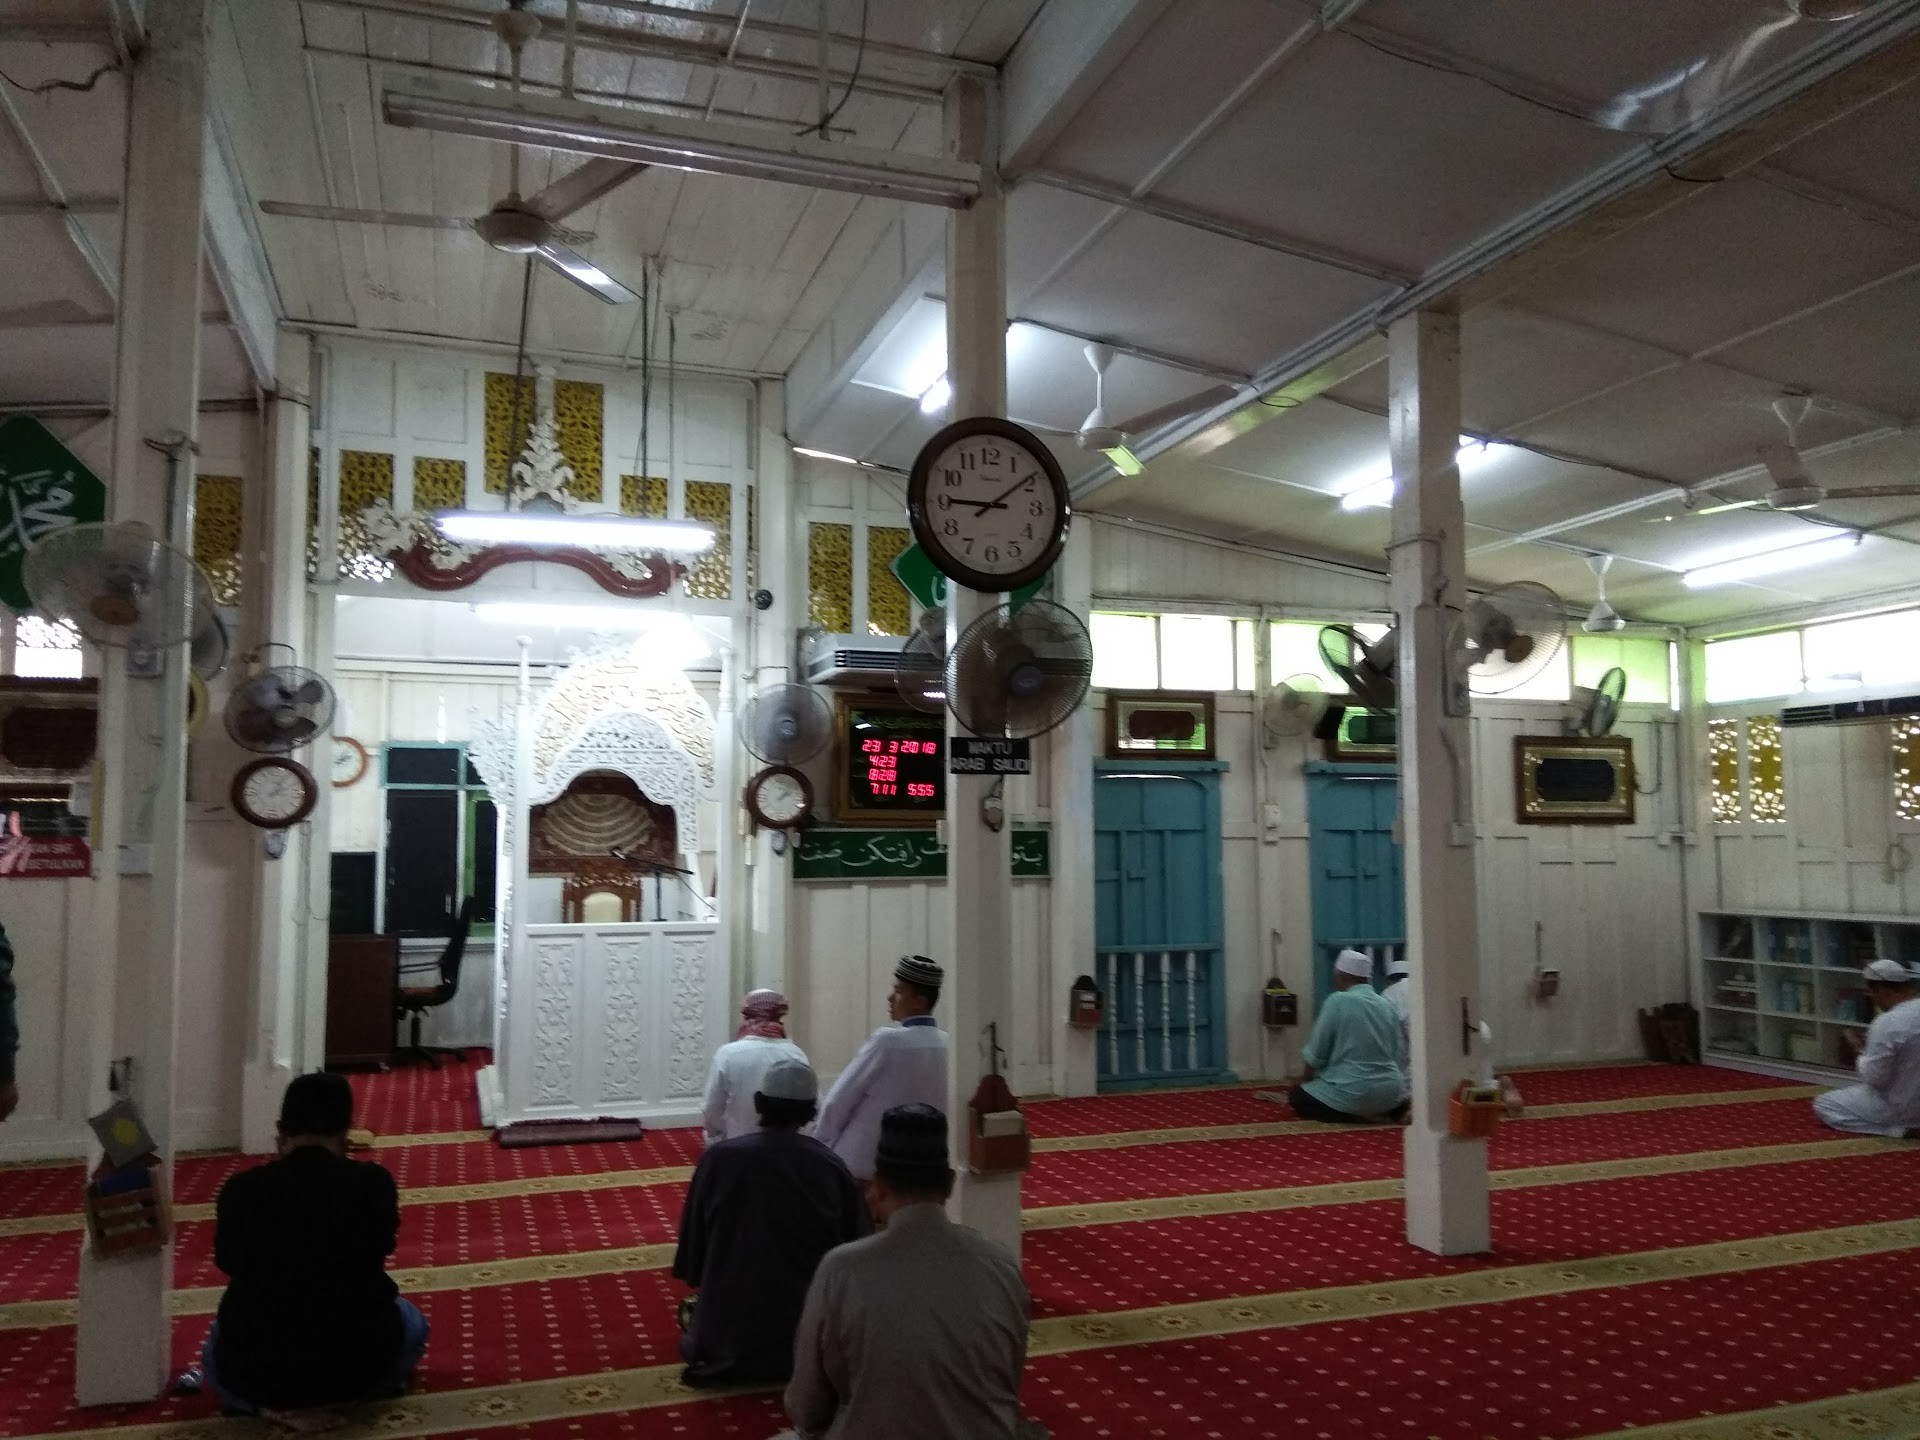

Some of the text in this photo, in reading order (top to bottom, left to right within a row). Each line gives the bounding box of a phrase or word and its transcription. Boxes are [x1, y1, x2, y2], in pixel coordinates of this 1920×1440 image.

[960, 452, 975, 470] 11
[981, 447, 1001, 466] 12
[1010, 456, 1017, 473] 1
[944, 469, 962, 487] 10
[937, 493, 951, 511] 9
[1030, 499, 1044, 516] 3
[944, 518, 959, 536] 8
[1019, 522, 1034, 540] 4
[962, 537, 975, 555] 7
[985, 545, 999, 563] 6
[1007, 540, 1022, 558] 5
[862, 739, 881, 753] 23
[889, 741, 898, 753] 3
[968, 741, 1013, 755] WAKTU
[951, 757, 1031, 771] ARAB SAUDI
